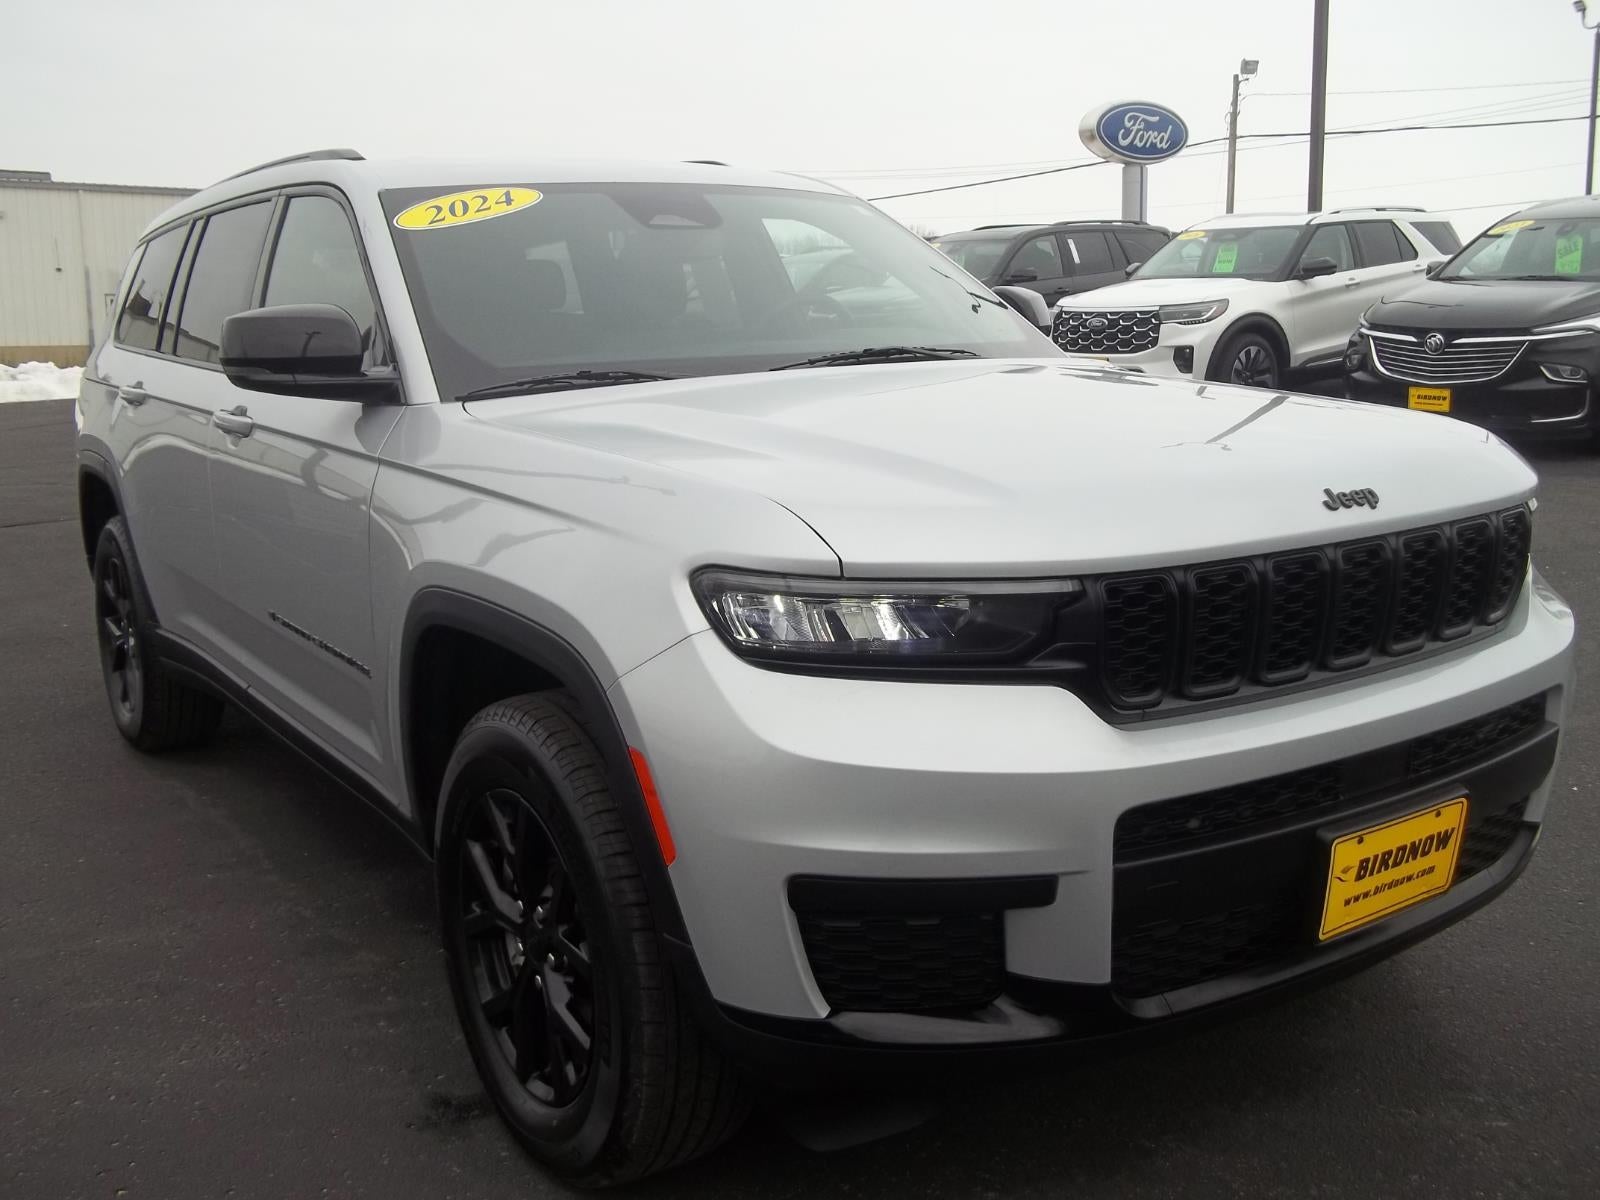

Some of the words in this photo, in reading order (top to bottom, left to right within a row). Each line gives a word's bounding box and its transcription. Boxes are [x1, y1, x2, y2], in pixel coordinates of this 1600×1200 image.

[1118, 112, 1172, 149] Ford
[425, 190, 515, 225] 2024
[1322, 487, 1380, 511] Jeep
[1354, 827, 1456, 882] BIRDNOW
[1343, 865, 1436, 907] www.birdnow.com
